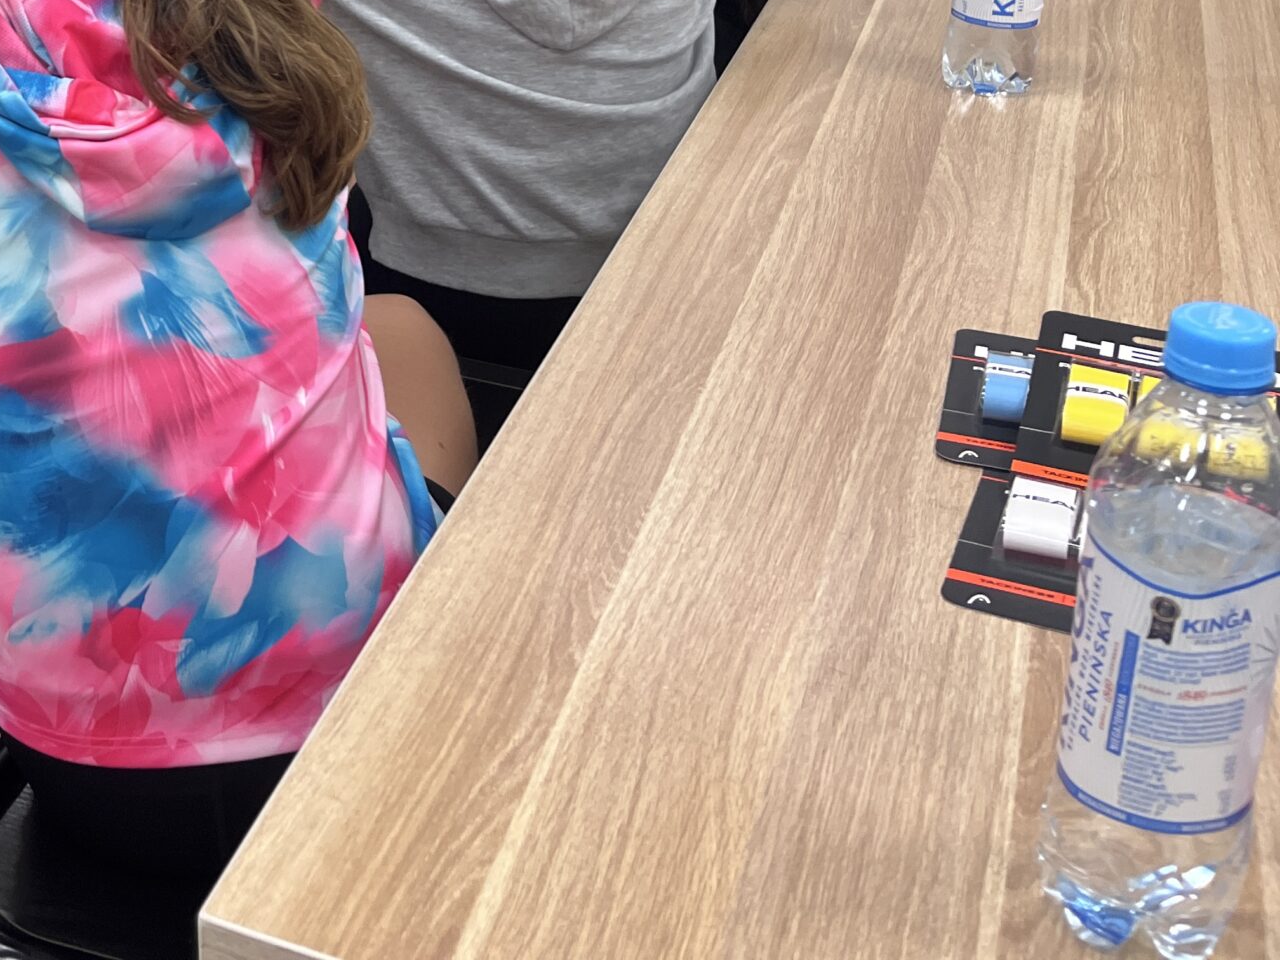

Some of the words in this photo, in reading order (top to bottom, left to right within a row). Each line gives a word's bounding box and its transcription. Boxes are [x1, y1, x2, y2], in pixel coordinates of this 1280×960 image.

[1061, 333, 1165, 366] HE
[1042, 469, 1088, 482] TACKIN
[1012, 493, 1075, 512] HEA
[1182, 608, 1252, 637] KINGA
